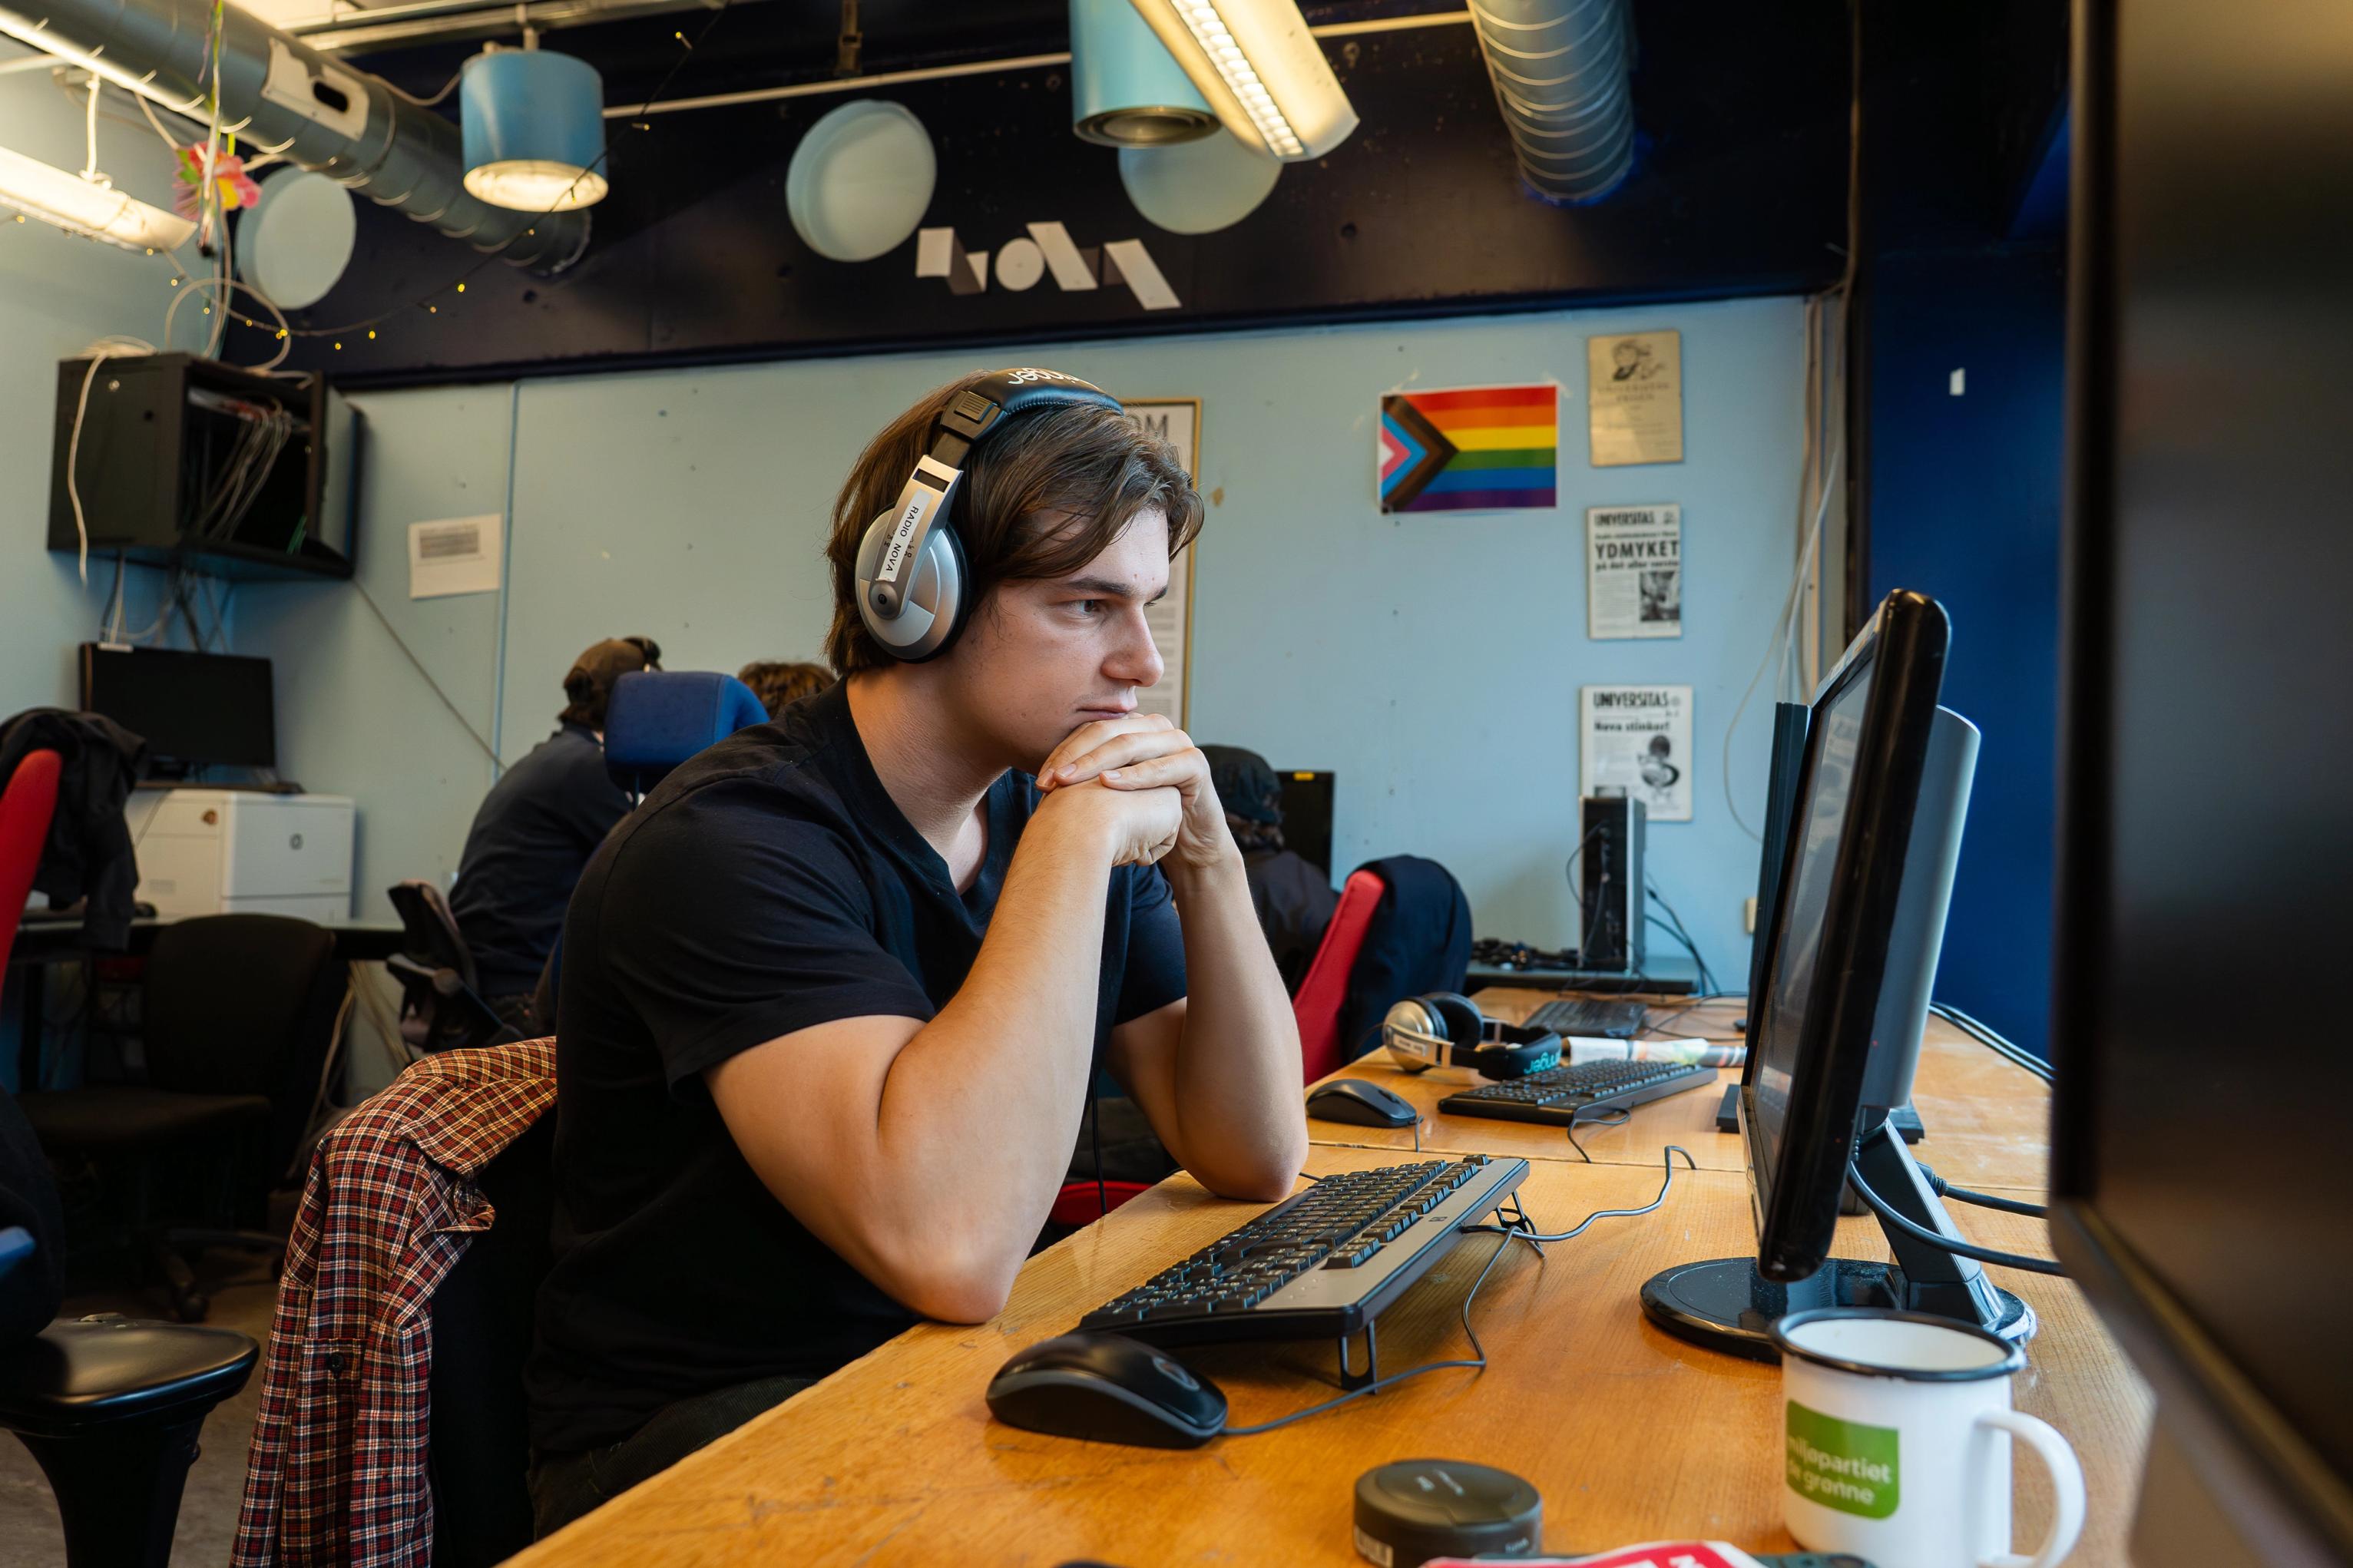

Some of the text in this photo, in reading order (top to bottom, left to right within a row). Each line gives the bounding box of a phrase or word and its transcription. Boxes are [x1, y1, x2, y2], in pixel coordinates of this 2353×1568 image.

[900, 506, 919, 537] RADIO
[1595, 511, 1654, 525] UNIVERSITAS
[885, 543, 902, 571] NOVA
[1595, 541, 1679, 559] YDMYKET
[1593, 693, 1668, 706] UNIVERSITAS
